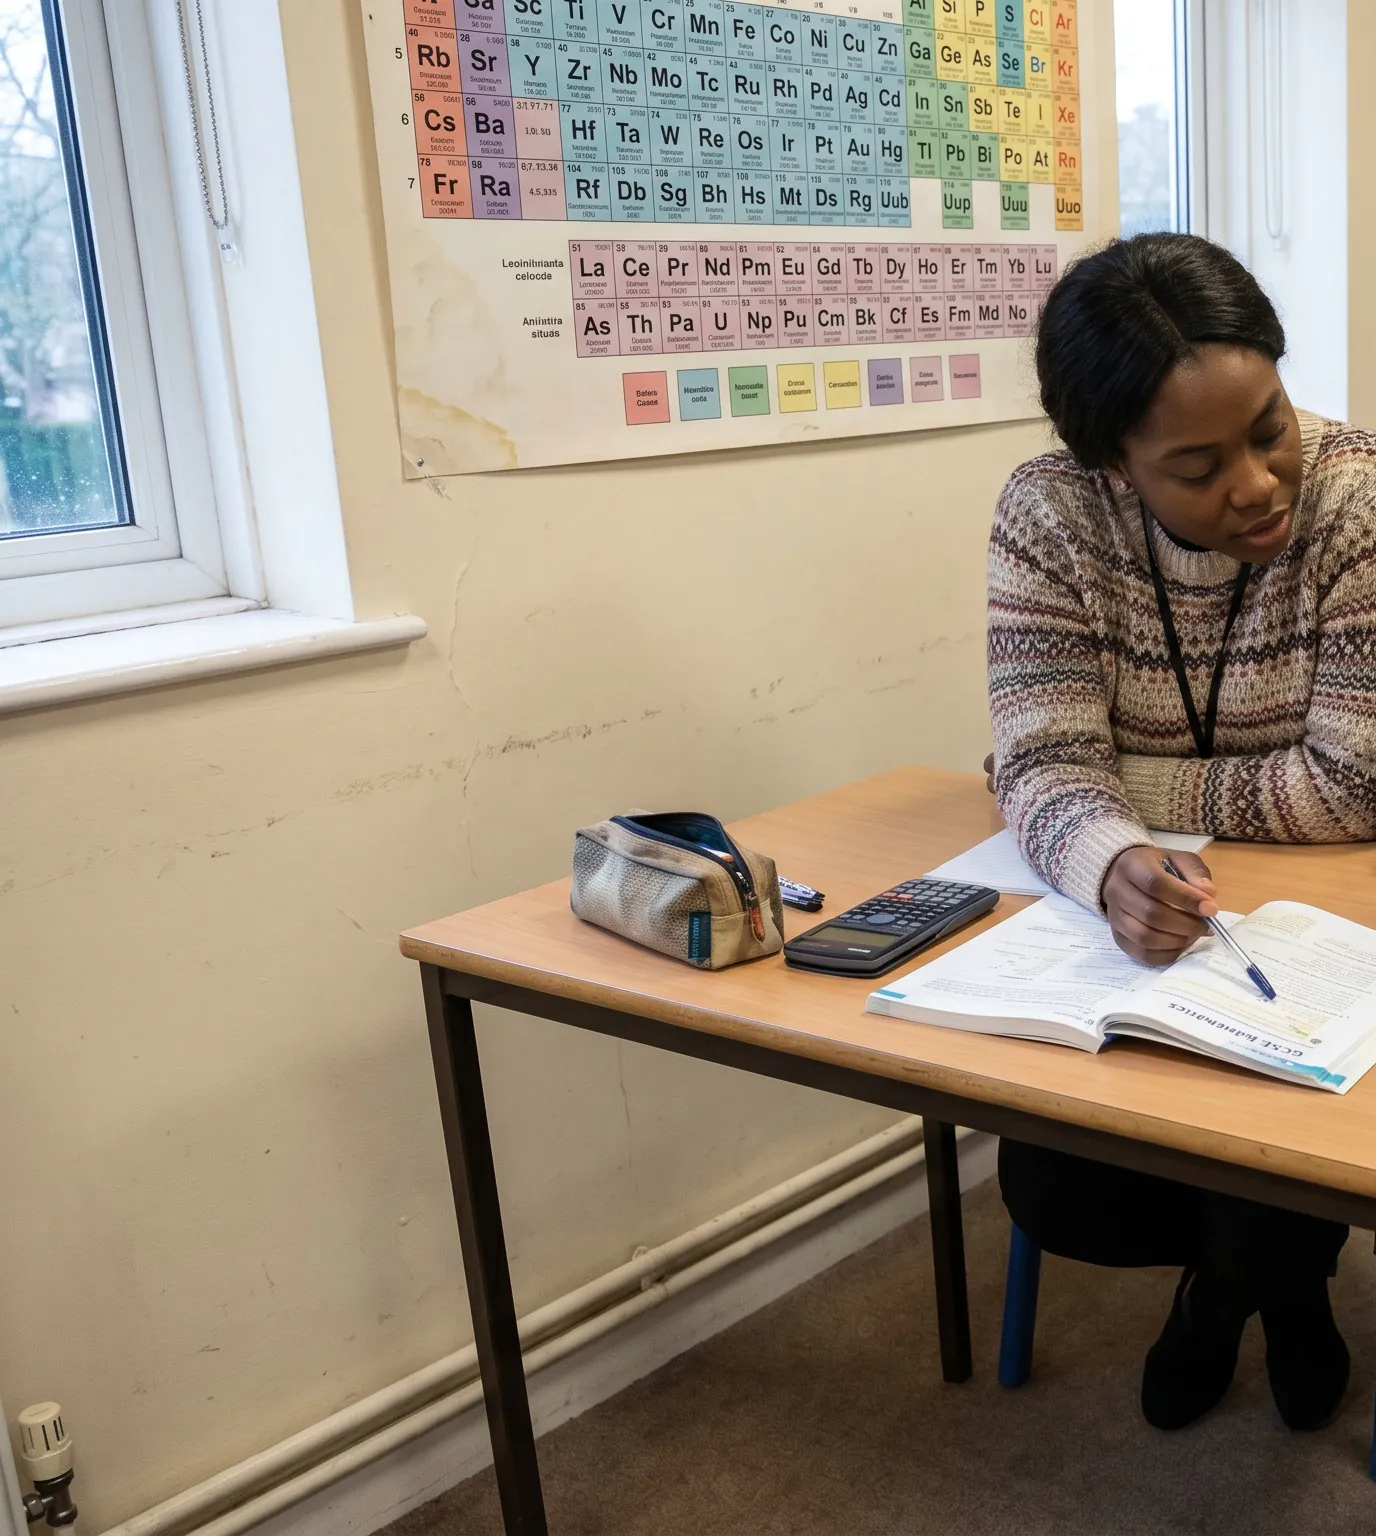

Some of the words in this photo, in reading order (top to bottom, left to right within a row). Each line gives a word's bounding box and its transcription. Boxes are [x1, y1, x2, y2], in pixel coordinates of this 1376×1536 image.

[514, 0, 542, 15] Sc
[564, 0, 583, 19] Ti
[612, 4, 626, 24] V
[976, 1, 984, 16] P
[1005, 5, 1014, 22] S
[652, 9, 675, 30] Cr
[690, 14, 719, 35] Mn
[1030, 9, 1042, 26] Cl
[1056, 13, 1071, 29] Ar
[734, 19, 755, 39] Fe
[771, 24, 794, 44] Co
[811, 29, 827, 48] Ni
[843, 34, 864, 52] Cu
[878, 37, 897, 56] Zn
[396, 48, 402, 59] 5
[418, 44, 450, 67] Rb
[910, 42, 930, 60] Ga
[941, 46, 961, 63] Ge
[973, 50, 991, 67] As
[471, 50, 497, 71] Sr
[525, 55, 540, 75] Y
[1002, 53, 1019, 70] Se
[1031, 56, 1046, 73] Br
[1058, 60, 1073, 76] Kr
[568, 59, 590, 80] Zr
[610, 63, 637, 84] Nb
[652, 67, 681, 88] Mo
[696, 72, 718, 91] Tc
[735, 75, 759, 95] Ru
[774, 79, 797, 98] Rh
[811, 82, 832, 101] Pd
[846, 86, 867, 109] Ag
[879, 89, 900, 107] Cd
[916, 92, 929, 110] In
[944, 96, 963, 113] Sn
[974, 98, 992, 115] Sb
[1005, 101, 1020, 118] Te
[402, 113, 409, 125] 6
[425, 109, 455, 131] Cs
[475, 113, 505, 134] Ba
[1059, 107, 1074, 123] Xe
[572, 119, 595, 140] Hf
[616, 123, 640, 143] Ta
[661, 125, 679, 145] W
[699, 128, 723, 148] Re
[738, 131, 763, 150] Os
[783, 134, 794, 151] Ir
[816, 136, 833, 154] Pt
[848, 139, 869, 156] Au
[882, 140, 902, 162] Hg
[947, 144, 965, 161] Pb
[978, 146, 991, 162] Bi
[1005, 148, 1022, 164] Po
[1034, 151, 1048, 166] At
[1059, 152, 1075, 168] Rn
[408, 178, 414, 188] 7
[434, 174, 458, 194] Fr
[480, 175, 511, 196] Ra
[576, 179, 600, 199] Rf
[618, 181, 646, 200] Db
[661, 183, 686, 206] Sg
[702, 184, 727, 203] Bh
[742, 186, 765, 204] Hs
[781, 188, 802, 205] Mt
[816, 189, 837, 206] Ds
[850, 190, 871, 212] Rg
[882, 192, 908, 208] Uub
[944, 194, 970, 213] Uup
[1003, 196, 1027, 212] Uuu
[1057, 198, 1080, 213] Uuo
[580, 258, 605, 276] La
[623, 258, 649, 276] Ce
[668, 258, 688, 276] Pr
[705, 258, 730, 275] Nd
[742, 258, 770, 275] Pm
[783, 258, 804, 275] Eu
[818, 258, 840, 275] Gd
[853, 258, 872, 275] Tb
[887, 259, 905, 279] Dy
[919, 259, 937, 274] Ho
[952, 259, 966, 274] Er
[977, 259, 997, 273] Tm
[1009, 259, 1025, 273] Yb
[1036, 259, 1051, 273] Lu
[784, 311, 806, 327] Pu
[818, 310, 844, 327] Cm
[856, 309, 876, 325] Bk
[890, 308, 907, 324] Cf
[922, 307, 938, 323] Es
[950, 307, 970, 321] Fm
[979, 305, 999, 320] Md
[1009, 305, 1026, 319] No
[584, 317, 610, 335] As
[627, 315, 652, 333] Th
[670, 314, 693, 332] Pa
[715, 313, 727, 330] U
[748, 312, 771, 333] Np
[1261, 1040, 1303, 1057] GCSE
